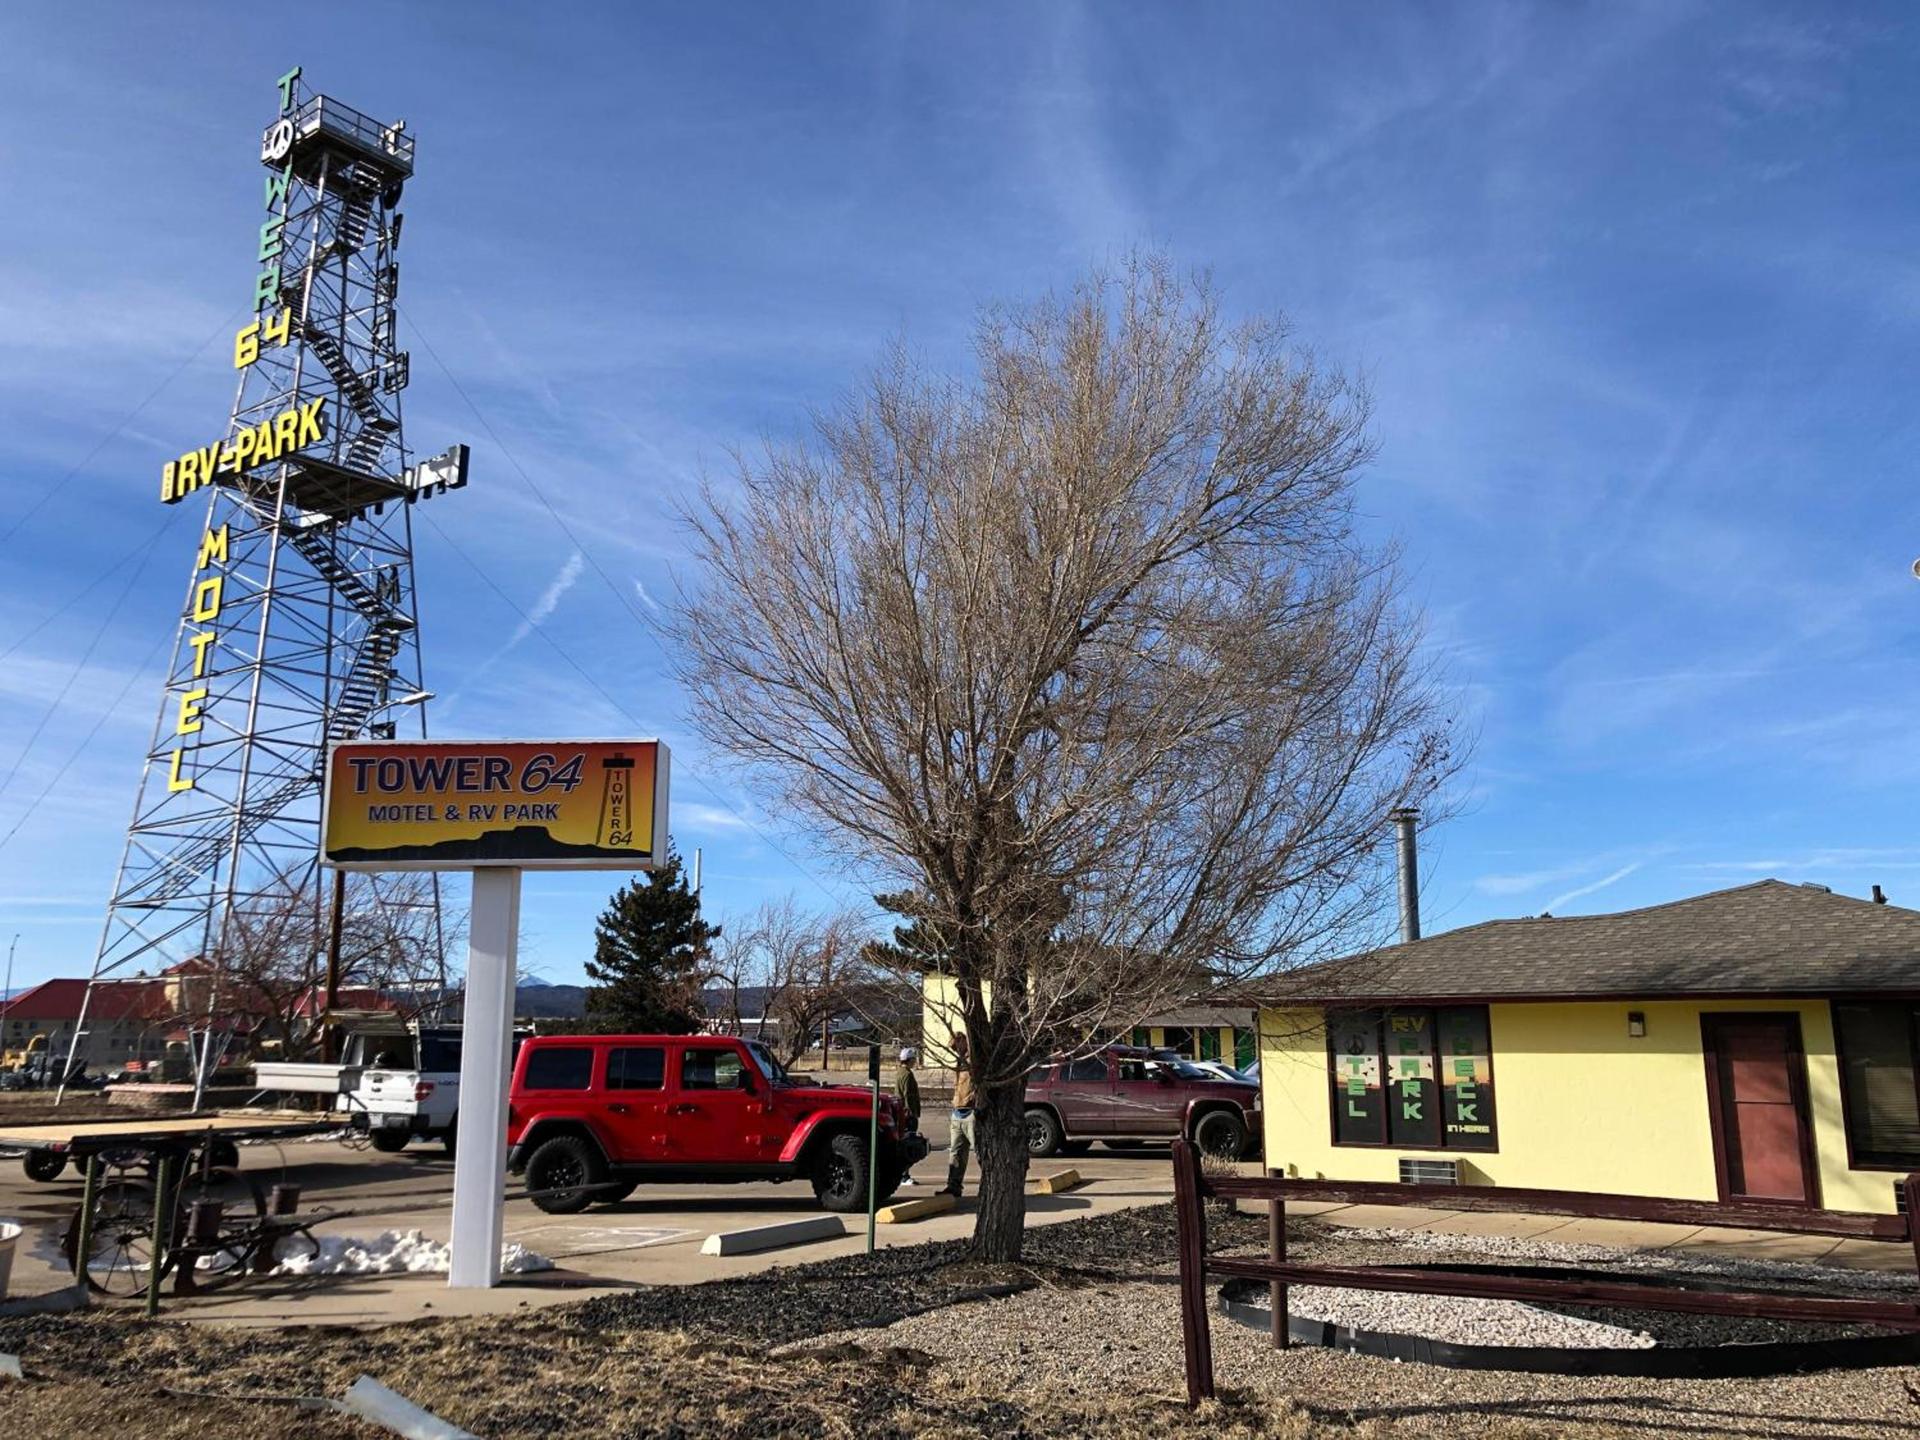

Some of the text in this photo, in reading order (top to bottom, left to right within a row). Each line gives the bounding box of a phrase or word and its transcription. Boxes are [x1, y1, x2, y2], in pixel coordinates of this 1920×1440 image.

[234, 307, 291, 370] 64
[177, 397, 327, 497] RV-PARK
[167, 523, 230, 793] MOTEL
[348, 753, 586, 794] TOWER 64
[610, 770, 622, 829] TOWER
[368, 803, 560, 822] MOTEL & RV PARK
[609, 830, 633, 846] 64
[1391, 1016, 1426, 1033] RV
[1399, 1037, 1423, 1120] PARK
